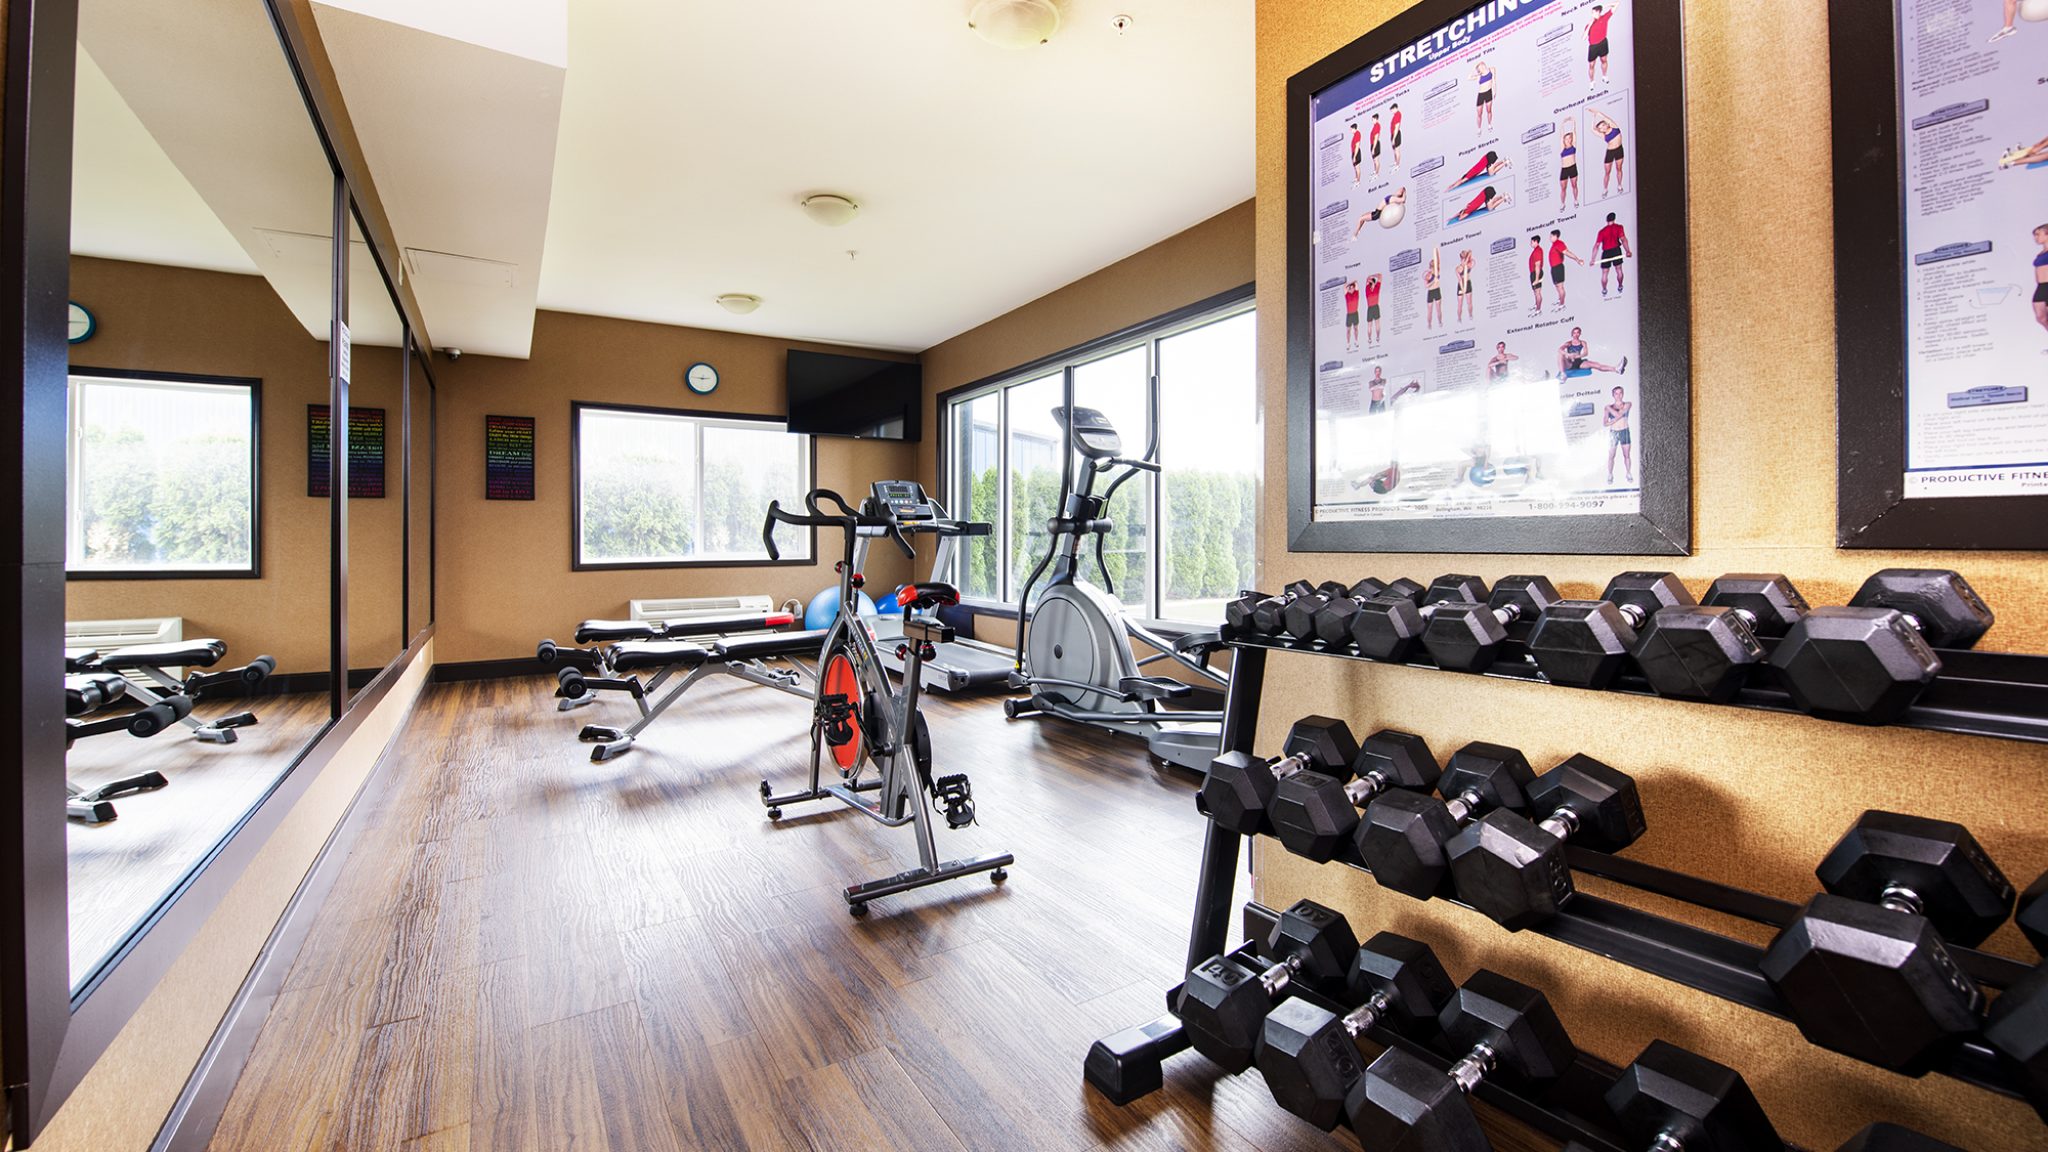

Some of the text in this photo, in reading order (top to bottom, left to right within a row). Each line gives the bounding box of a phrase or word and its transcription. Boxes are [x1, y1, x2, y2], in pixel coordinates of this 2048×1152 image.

[1561, 6, 1577, 16] Neck
[1429, 35, 1471, 60] Upper Body
[1553, 98, 1585, 114] Overhead
[1587, 89, 1609, 101] Reach
[1478, 138, 1499, 148] Stretch
[1526, 214, 1577, 232] Handcuff Towel
[1440, 231, 1482, 247] Shoulder Towel
[1507, 325, 1533, 334] External
[1535, 320, 1558, 329] Rotator
[1576, 389, 1601, 397] Deltoid
[1921, 473, 2005, 483] PRODUCTIVE
[1208, 963, 1240, 986] 40
[1327, 1036, 1354, 1073] 40
